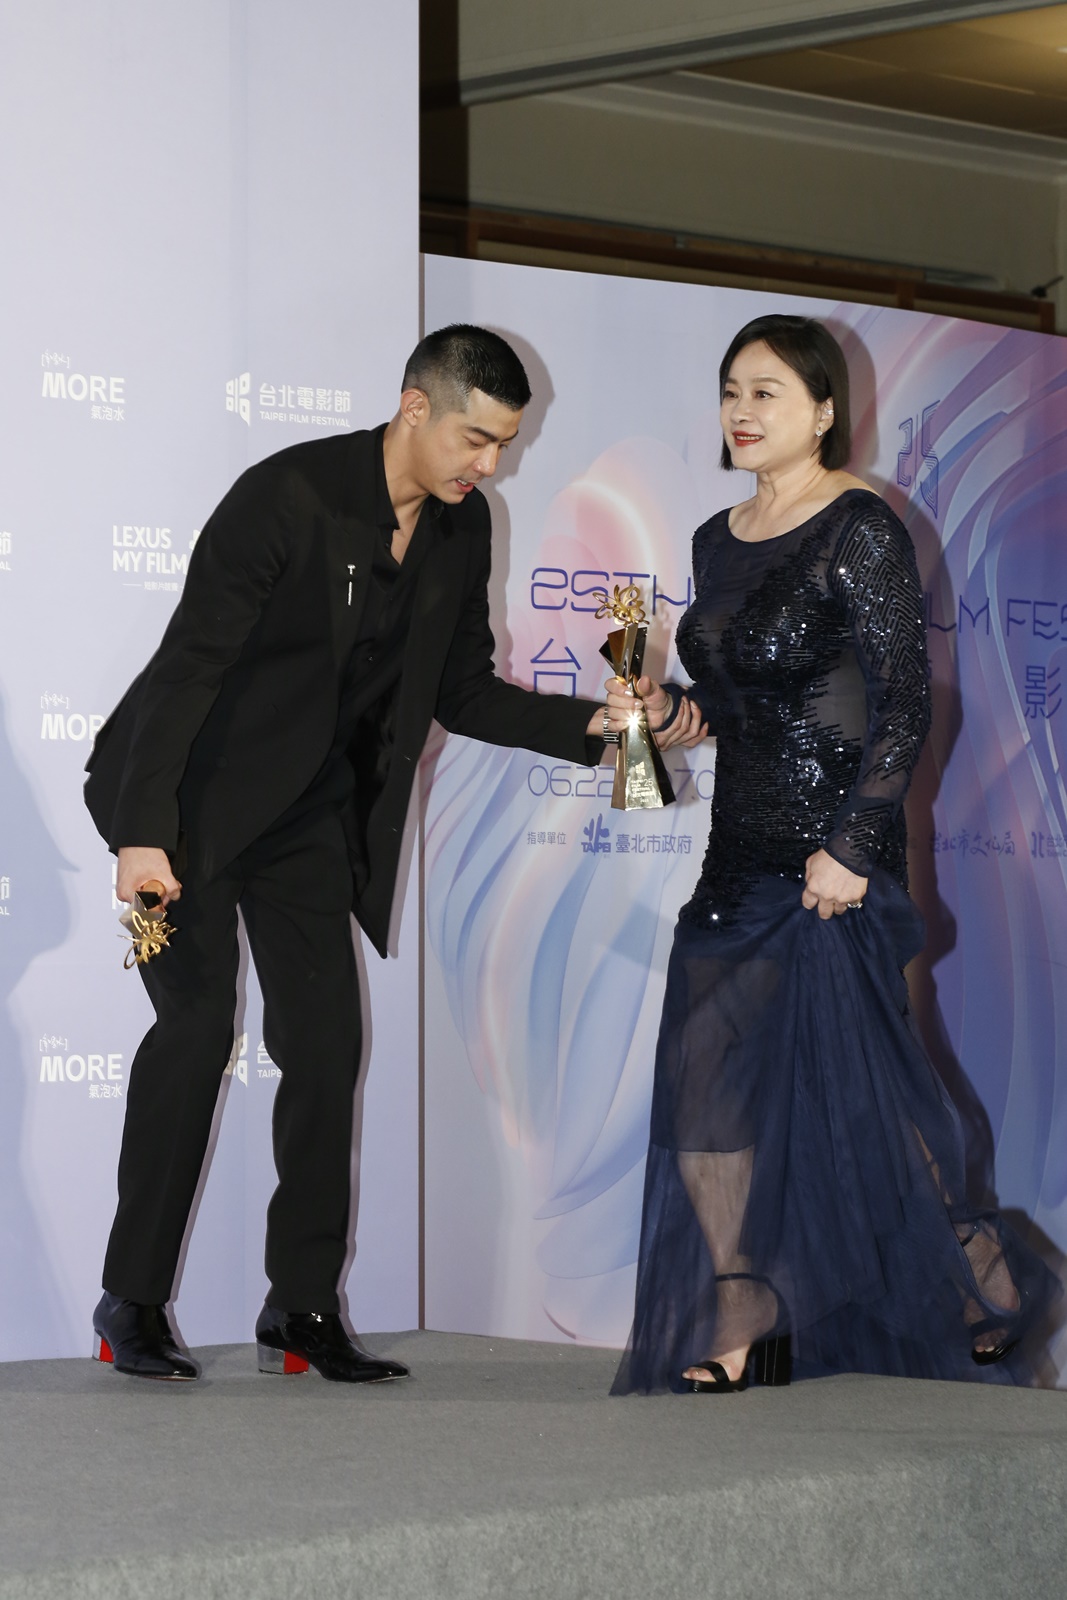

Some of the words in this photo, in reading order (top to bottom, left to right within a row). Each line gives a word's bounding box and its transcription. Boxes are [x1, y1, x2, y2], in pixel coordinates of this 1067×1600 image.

[41, 371, 125, 404] MORE
[259, 382, 351, 413] 台北電影節
[90, 405, 125, 421] 氣泡水
[259, 410, 287, 422] TAIPEI
[289, 413, 309, 424] FILM
[311, 415, 351, 428] FESTIVAL
[112, 525, 172, 549] LEXUS
[112, 550, 142, 572] MY
[146, 551, 188, 575] FILM
[1024, 665, 1063, 719] 影
[527, 831, 567, 845] 指導單位
[615, 833, 693, 854] 臺北市政府
[39, 1053, 123, 1083] MORE
[88, 1083, 123, 1099] 氣泡水
